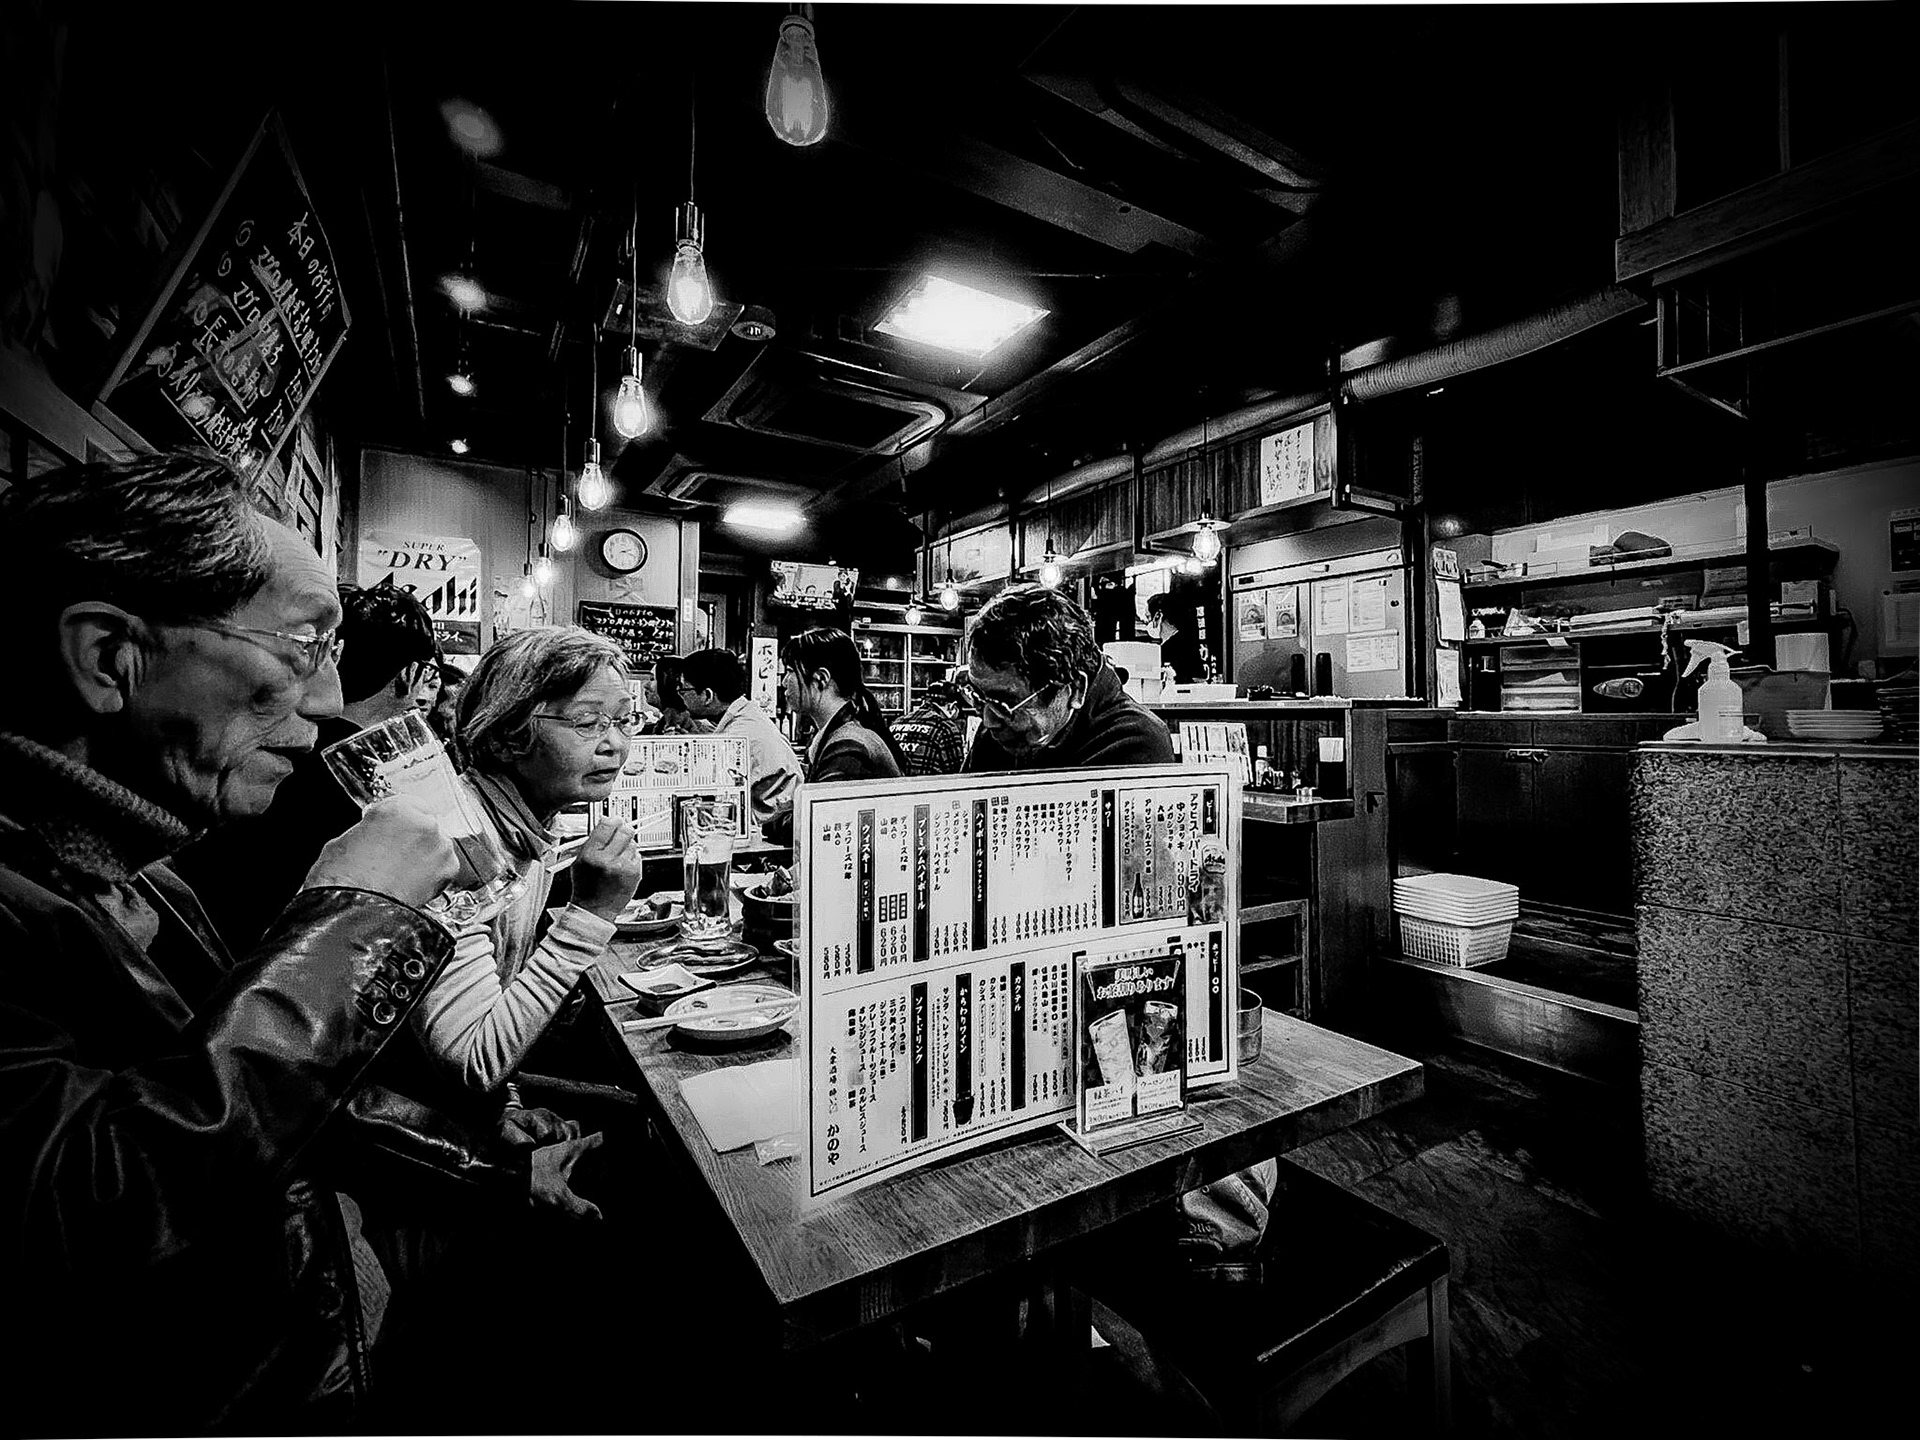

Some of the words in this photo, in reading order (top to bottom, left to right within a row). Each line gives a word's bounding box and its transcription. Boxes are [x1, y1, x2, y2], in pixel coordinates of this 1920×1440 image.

[403, 541, 445, 551] SUPER
[757, 644, 774, 693] ホッピー
[943, 811, 951, 875] コークハイボール
[975, 812, 984, 857] ハイボール
[1176, 802, 1185, 851] 中ジョッキ
[1188, 793, 1200, 892] アサヒスーパードライ
[917, 817, 926, 911] プレミアムハイボール
[1176, 861, 1186, 911] 390円
[880, 928, 888, 967] 620円
[900, 924, 908, 962] 490円
[1013, 976, 1022, 1012] カクテル
[868, 1003, 877, 1103] グレープフルーツジュース
[915, 996, 924, 1064] ソフトドリンク
[827, 1123, 840, 1166] かのや
[858, 1086, 867, 1154] カルピスジュース
